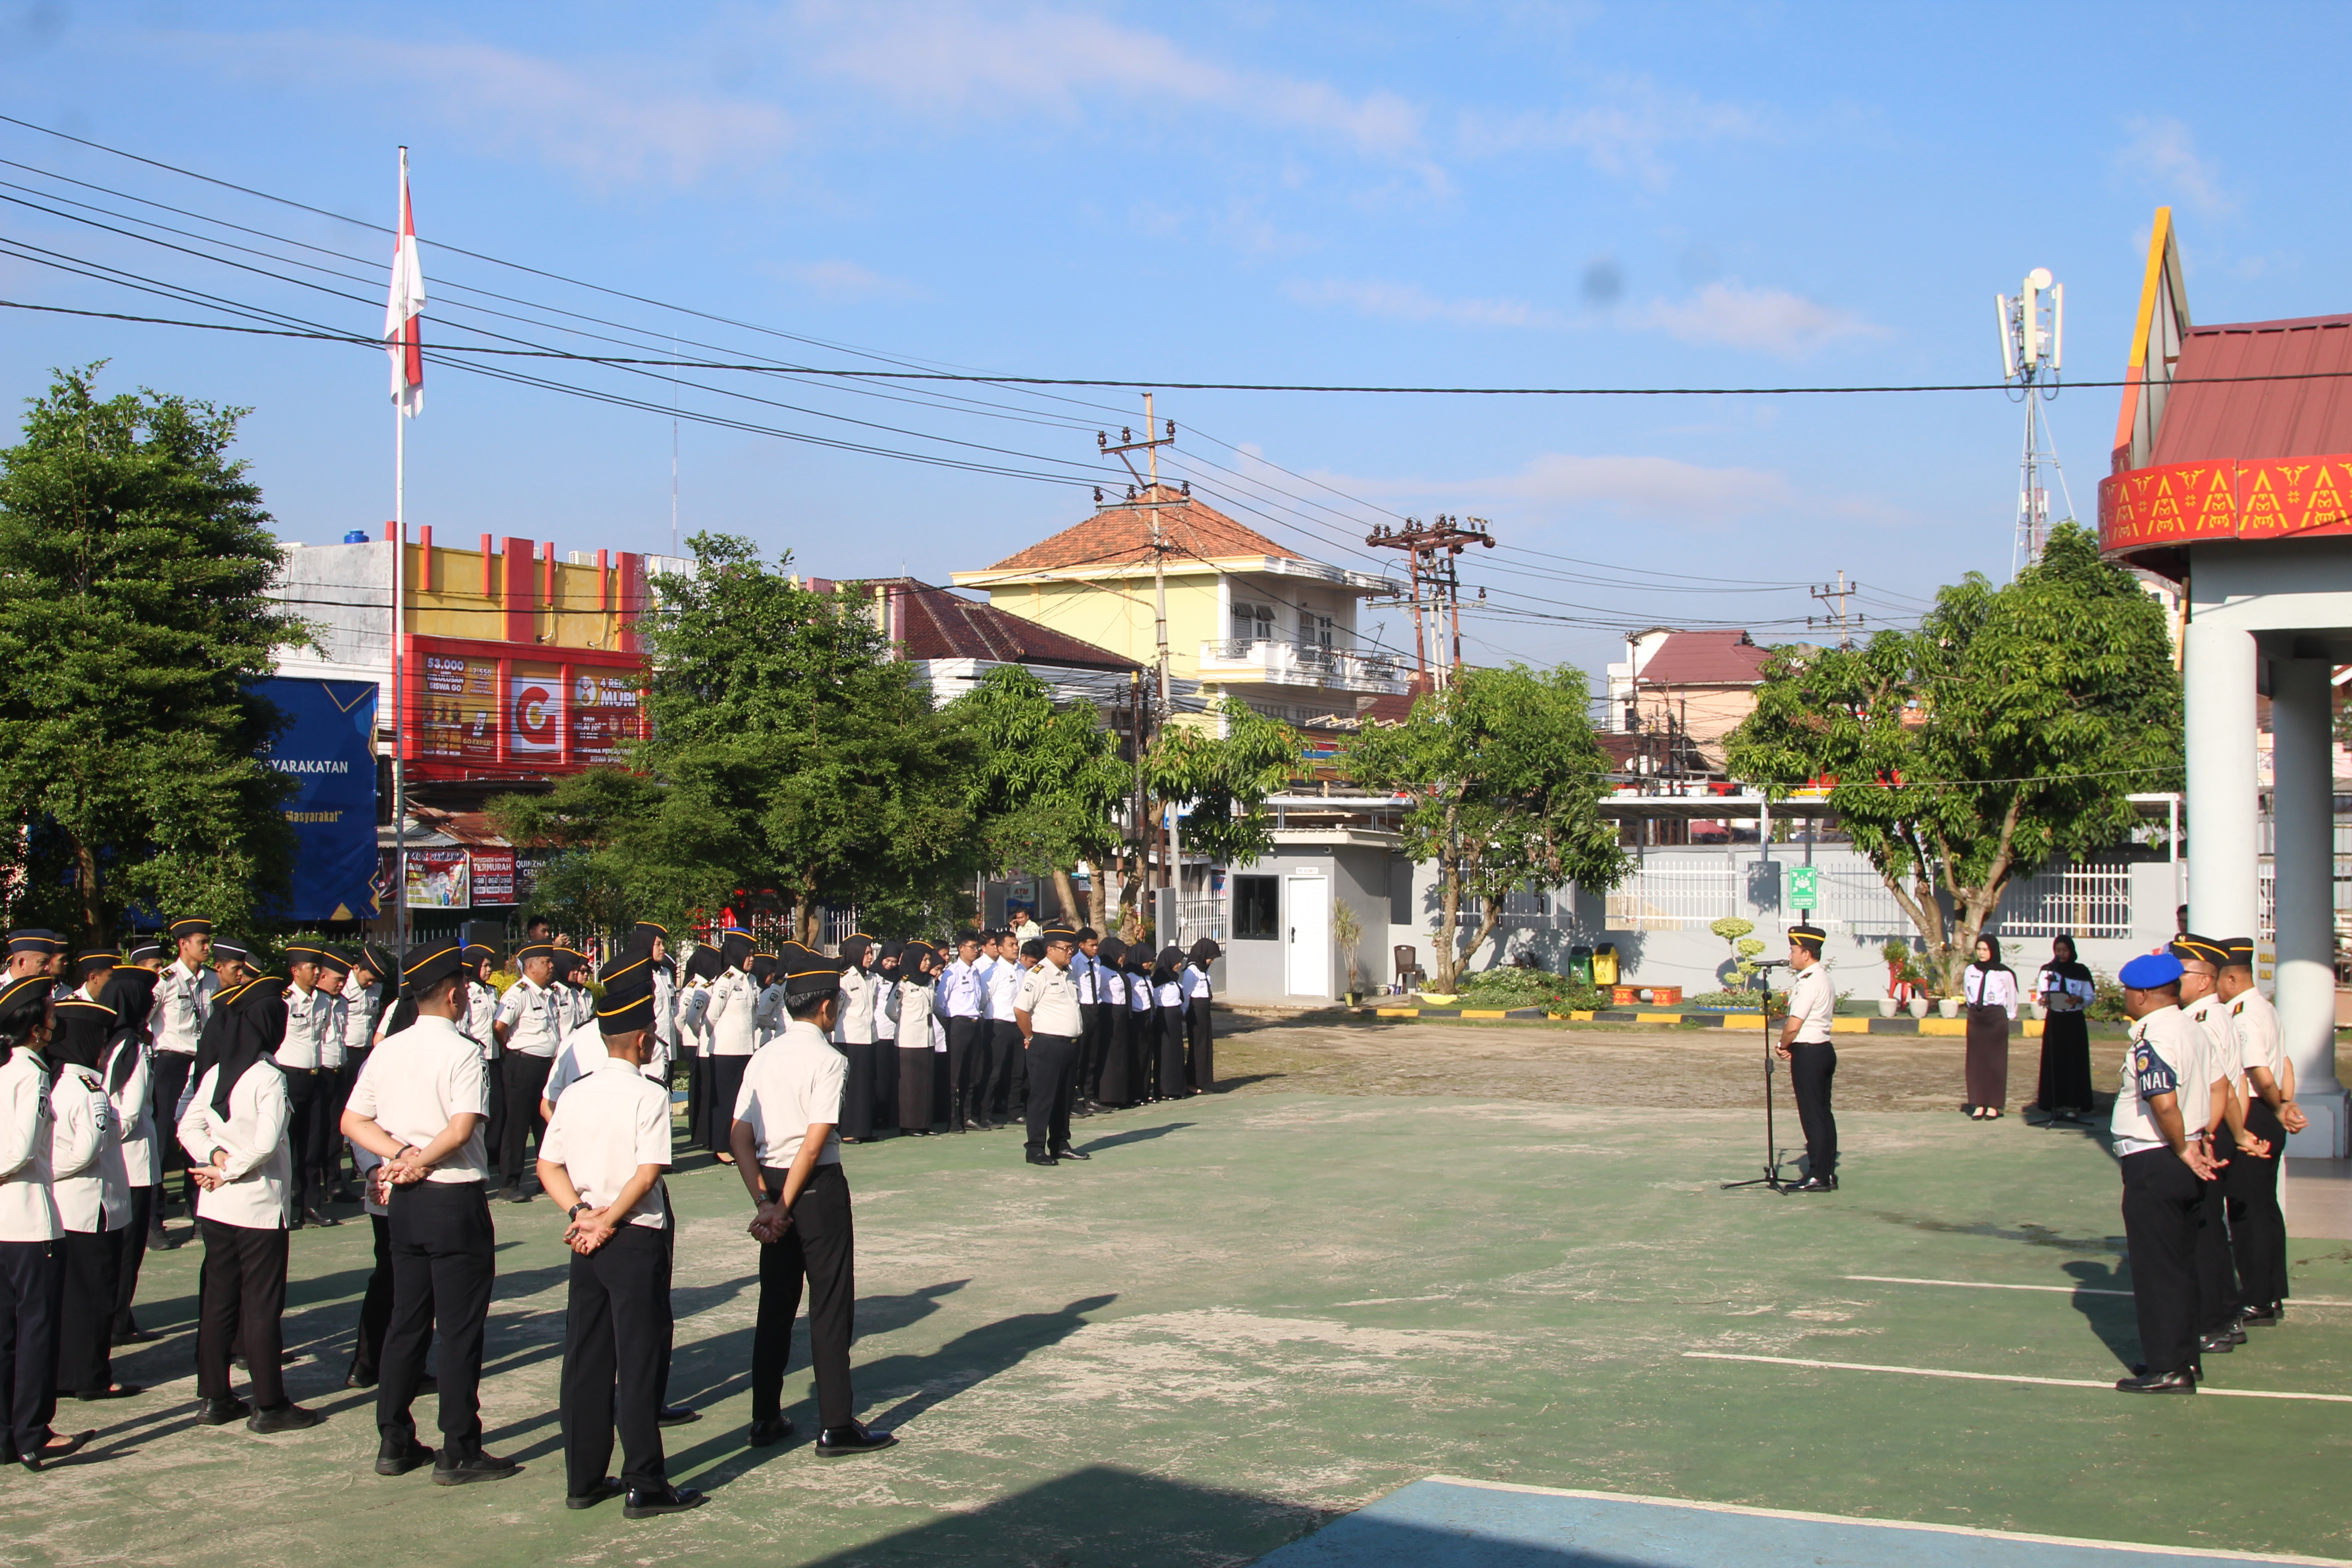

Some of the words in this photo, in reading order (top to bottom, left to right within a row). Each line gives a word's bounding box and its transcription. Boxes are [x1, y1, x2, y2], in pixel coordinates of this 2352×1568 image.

[427, 657, 464, 671] 53.000
[472, 667, 491, 676] 2.550
[429, 682, 450, 691] SISWA
[600, 678, 607, 688] 4
[600, 690, 636, 707] MURI
[268, 760, 348, 773] YARAKATAN
[473, 863, 511, 872] TERMURAH
